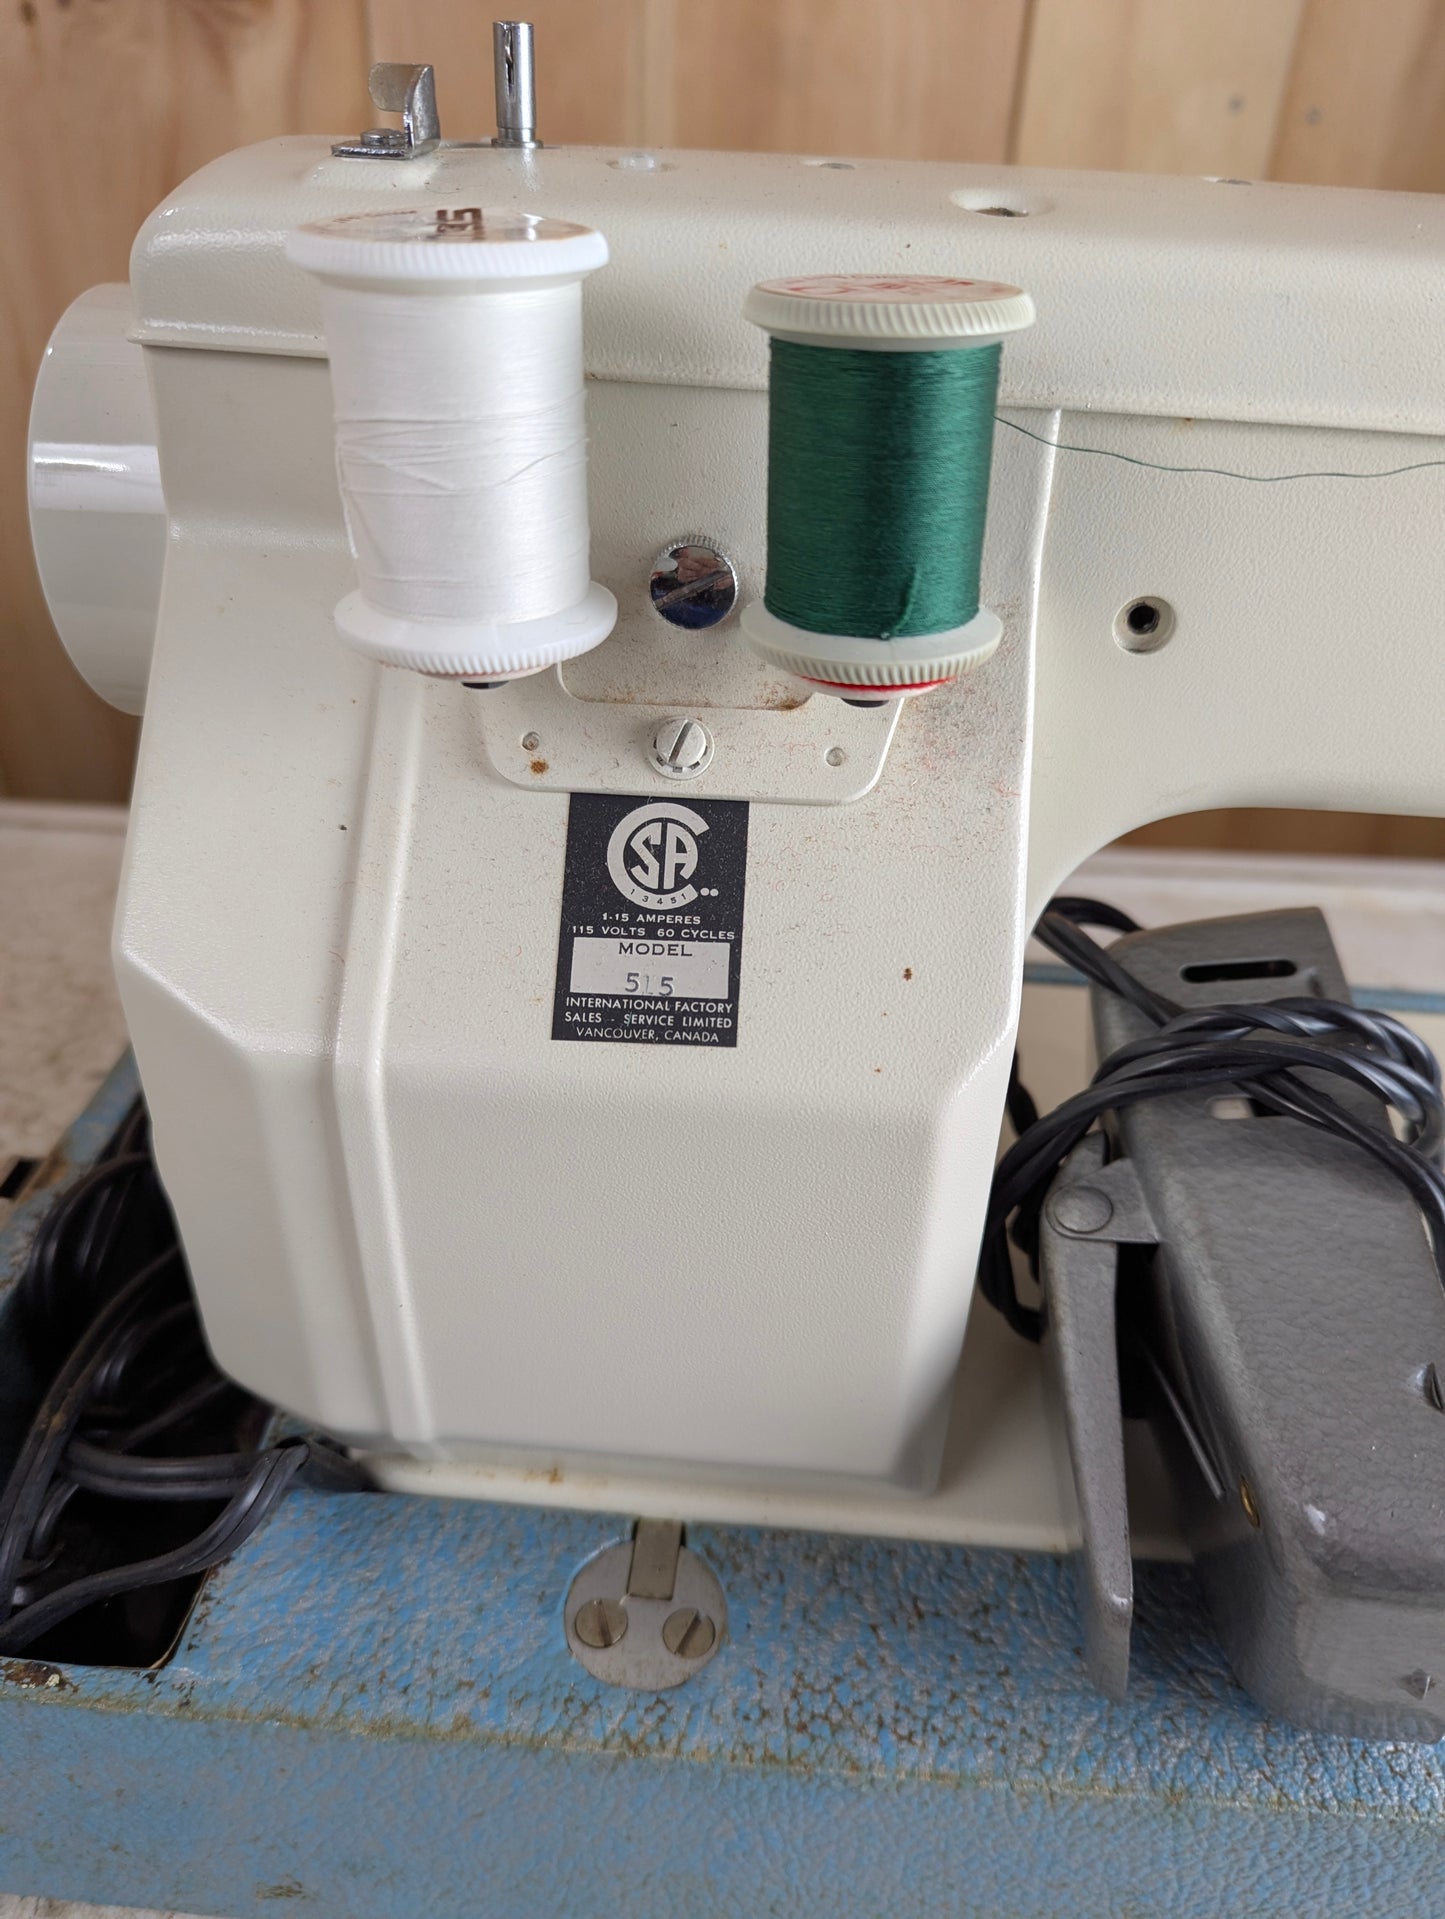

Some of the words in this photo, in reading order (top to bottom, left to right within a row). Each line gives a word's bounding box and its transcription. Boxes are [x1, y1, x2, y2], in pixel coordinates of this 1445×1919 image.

[606, 802, 710, 910] CSA
[636, 914, 701, 925] AMPERES
[572, 926, 594, 935] 115
[602, 927, 646, 936] VOLTS
[657, 929, 675, 938] 60
[681, 929, 735, 940] CYCLES
[618, 942, 693, 957] MODEL
[566, 997, 671, 1011] INTERNATIONAL
[675, 1001, 733, 1014] FACTORY
[564, 1011, 602, 1023] SALES
[623, 1013, 674, 1026] SERVICE
[682, 1016, 732, 1028] LIMITED
[576, 1027, 659, 1041] VANCOUVER,
[664, 1030, 719, 1043] CANADA
